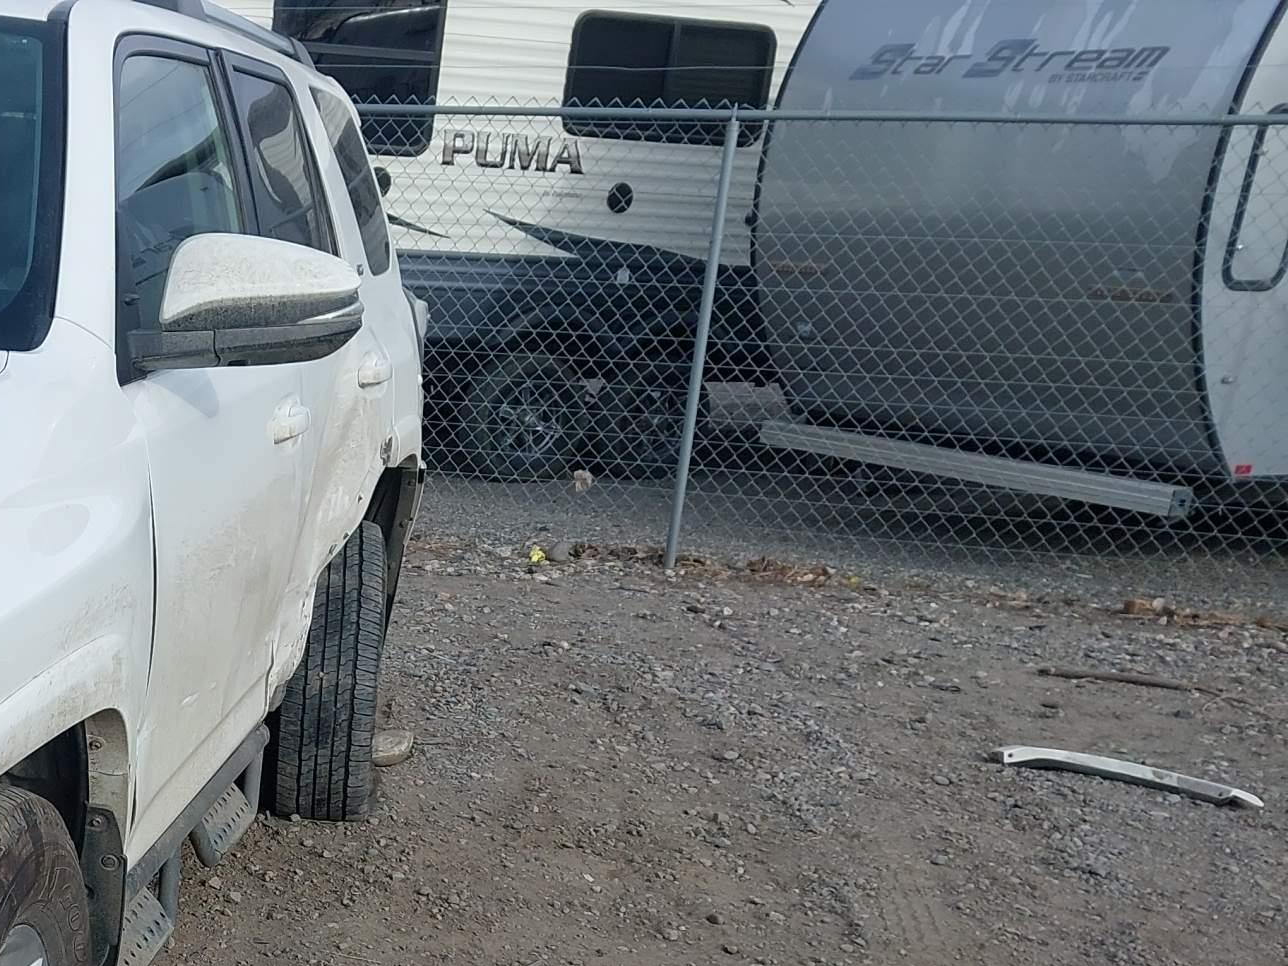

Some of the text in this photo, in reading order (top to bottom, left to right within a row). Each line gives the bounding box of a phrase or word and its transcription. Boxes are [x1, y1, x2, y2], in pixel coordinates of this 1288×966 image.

[848, 38, 1171, 80] Star Stream
[440, 129, 585, 174] PUMA
